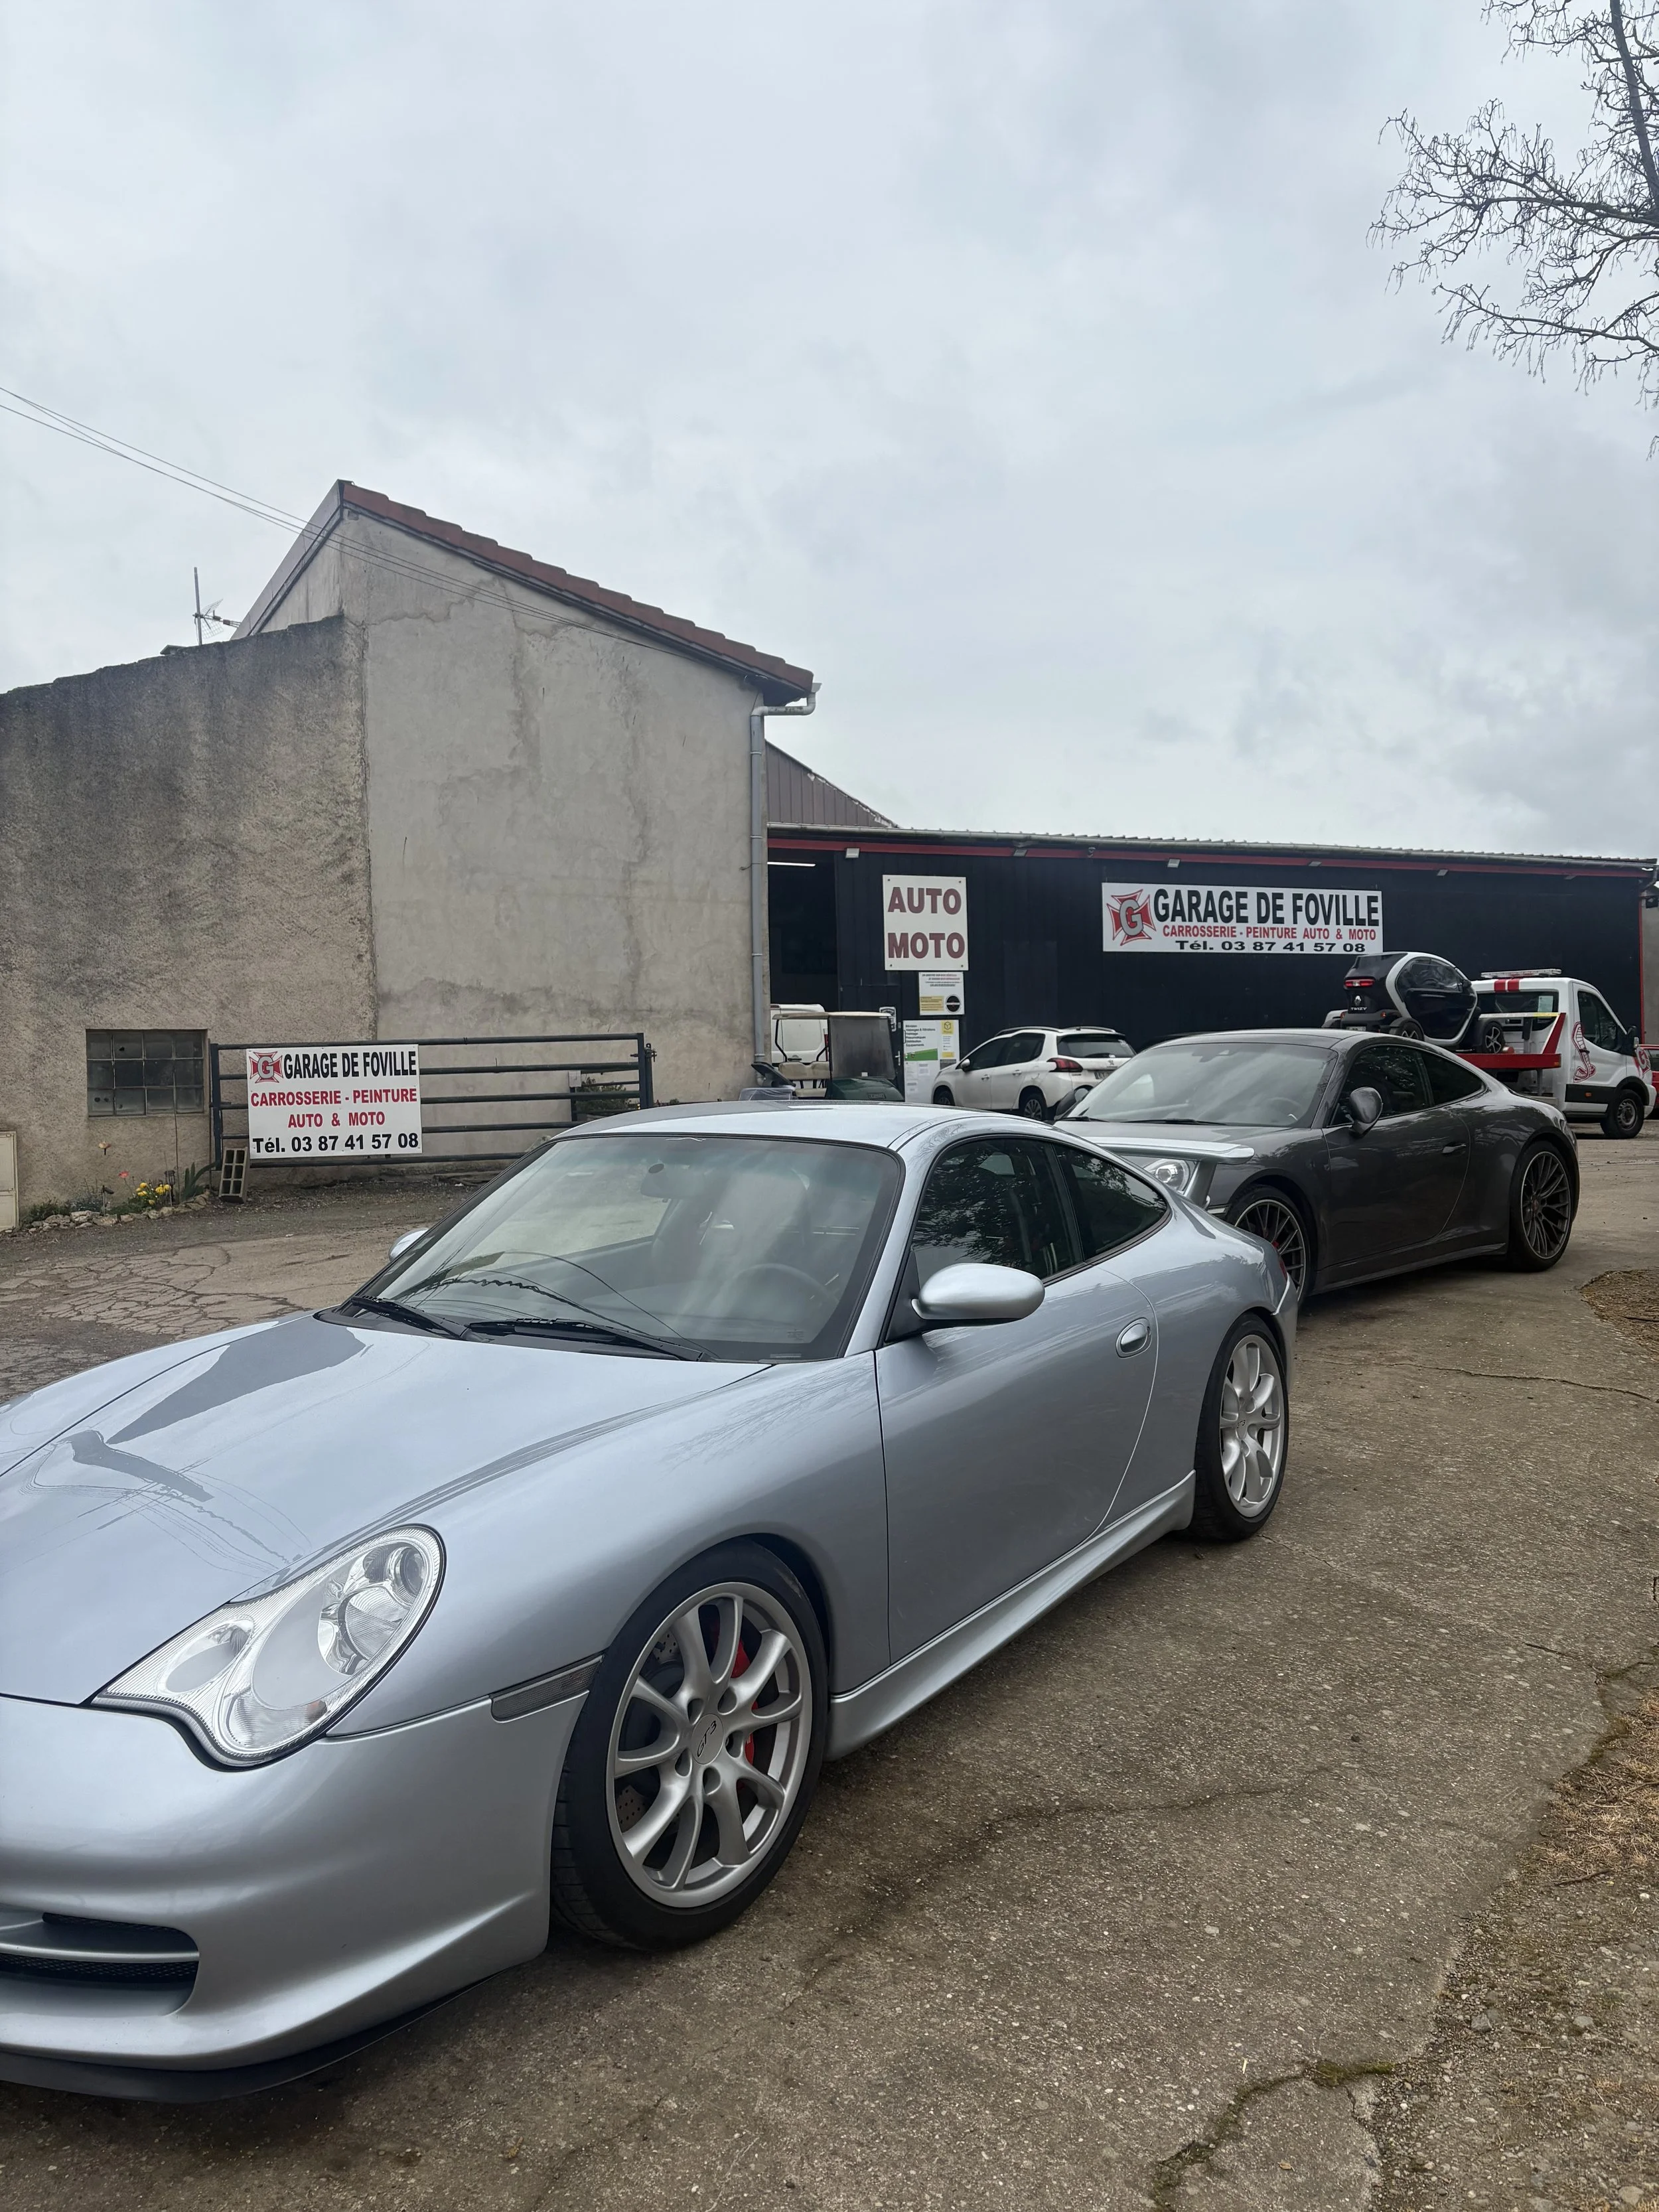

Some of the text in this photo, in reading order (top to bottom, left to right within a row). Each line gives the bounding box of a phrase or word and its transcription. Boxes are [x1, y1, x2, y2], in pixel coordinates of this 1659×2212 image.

[887, 887, 962, 915] AUTO
[1153, 889, 1380, 926] GARAGE DE FOVILLE
[1163, 925, 1236, 938] CARROSSERIE
[1246, 926, 1297, 938] PEINTURE
[1303, 928, 1329, 940] AUTO
[1336, 928, 1342, 940] &
[1349, 929, 1376, 940] MOTO
[887, 932, 965, 959] MOTO
[1175, 940, 1366, 952] Tél. 03 87 41 57 08
[283, 1051, 417, 1079] GARAGE DE FOVILLE
[251, 1090, 341, 1107] CARROSSERIE
[353, 1088, 417, 1104] PEINTURE
[288, 1111, 386, 1128] AUTO & MOTO
[253, 1133, 419, 1153] Tél. 03 87 41 57 08
[697, 1720, 717, 1757] GT3
